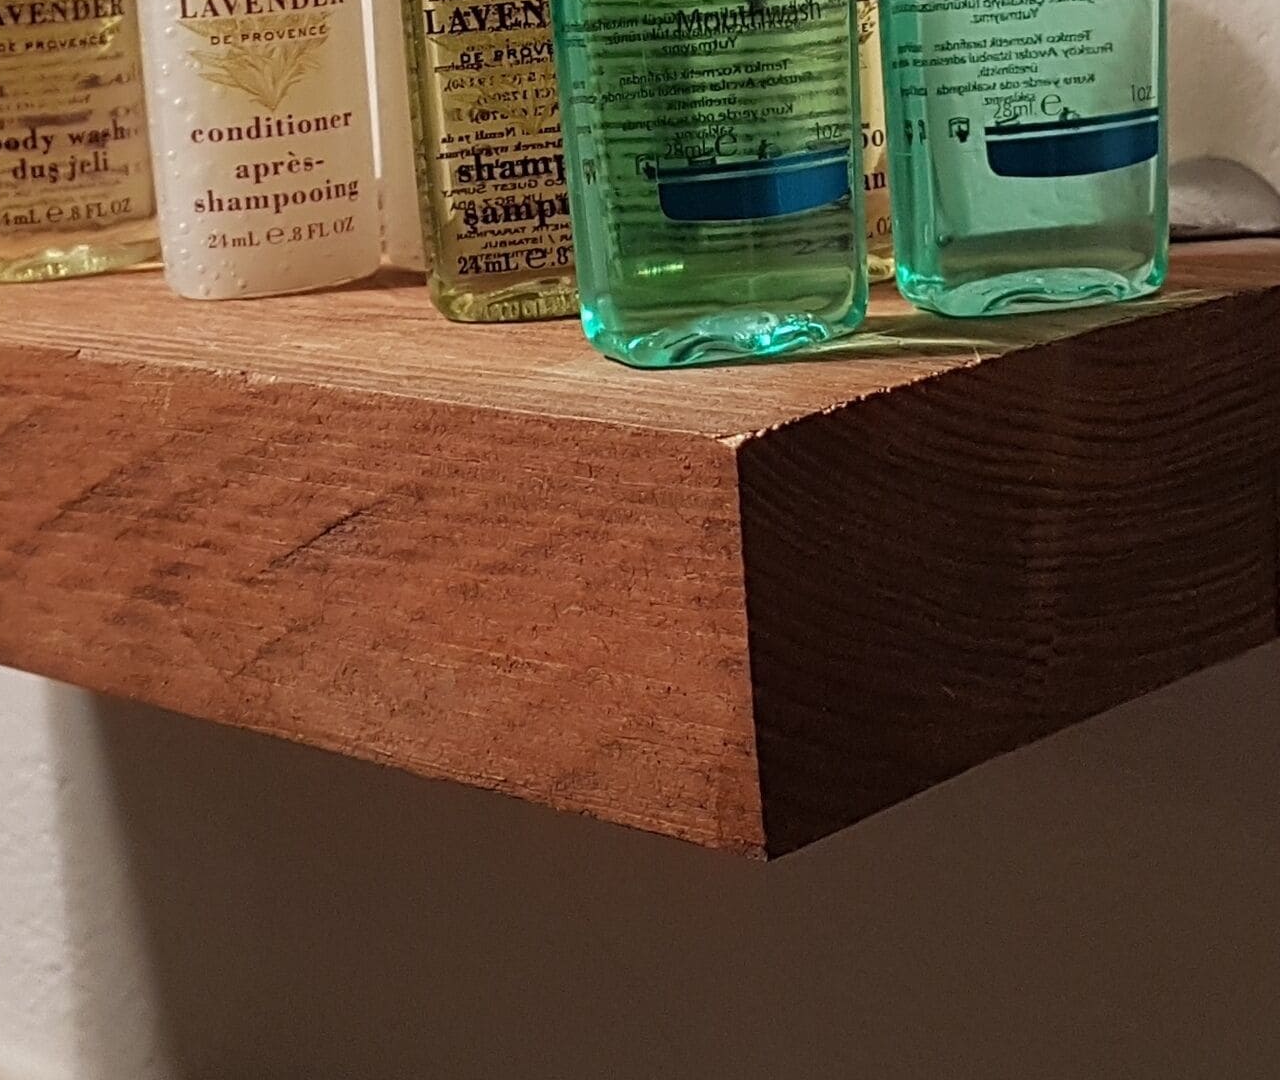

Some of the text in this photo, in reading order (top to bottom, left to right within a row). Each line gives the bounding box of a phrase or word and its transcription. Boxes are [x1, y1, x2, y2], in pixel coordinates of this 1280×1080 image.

[24, 33, 111, 51] PROVENCE
[210, 23, 328, 46] DE PROVENCE
[460, 52, 483, 64] DE
[190, 111, 353, 144] conditioner
[235, 151, 326, 185] après-
[193, 179, 360, 214] shampooing
[207, 230, 261, 249] 24mL
[306, 222, 330, 241] FL
[332, 216, 356, 234] OZ
[458, 254, 519, 275] 24mL
